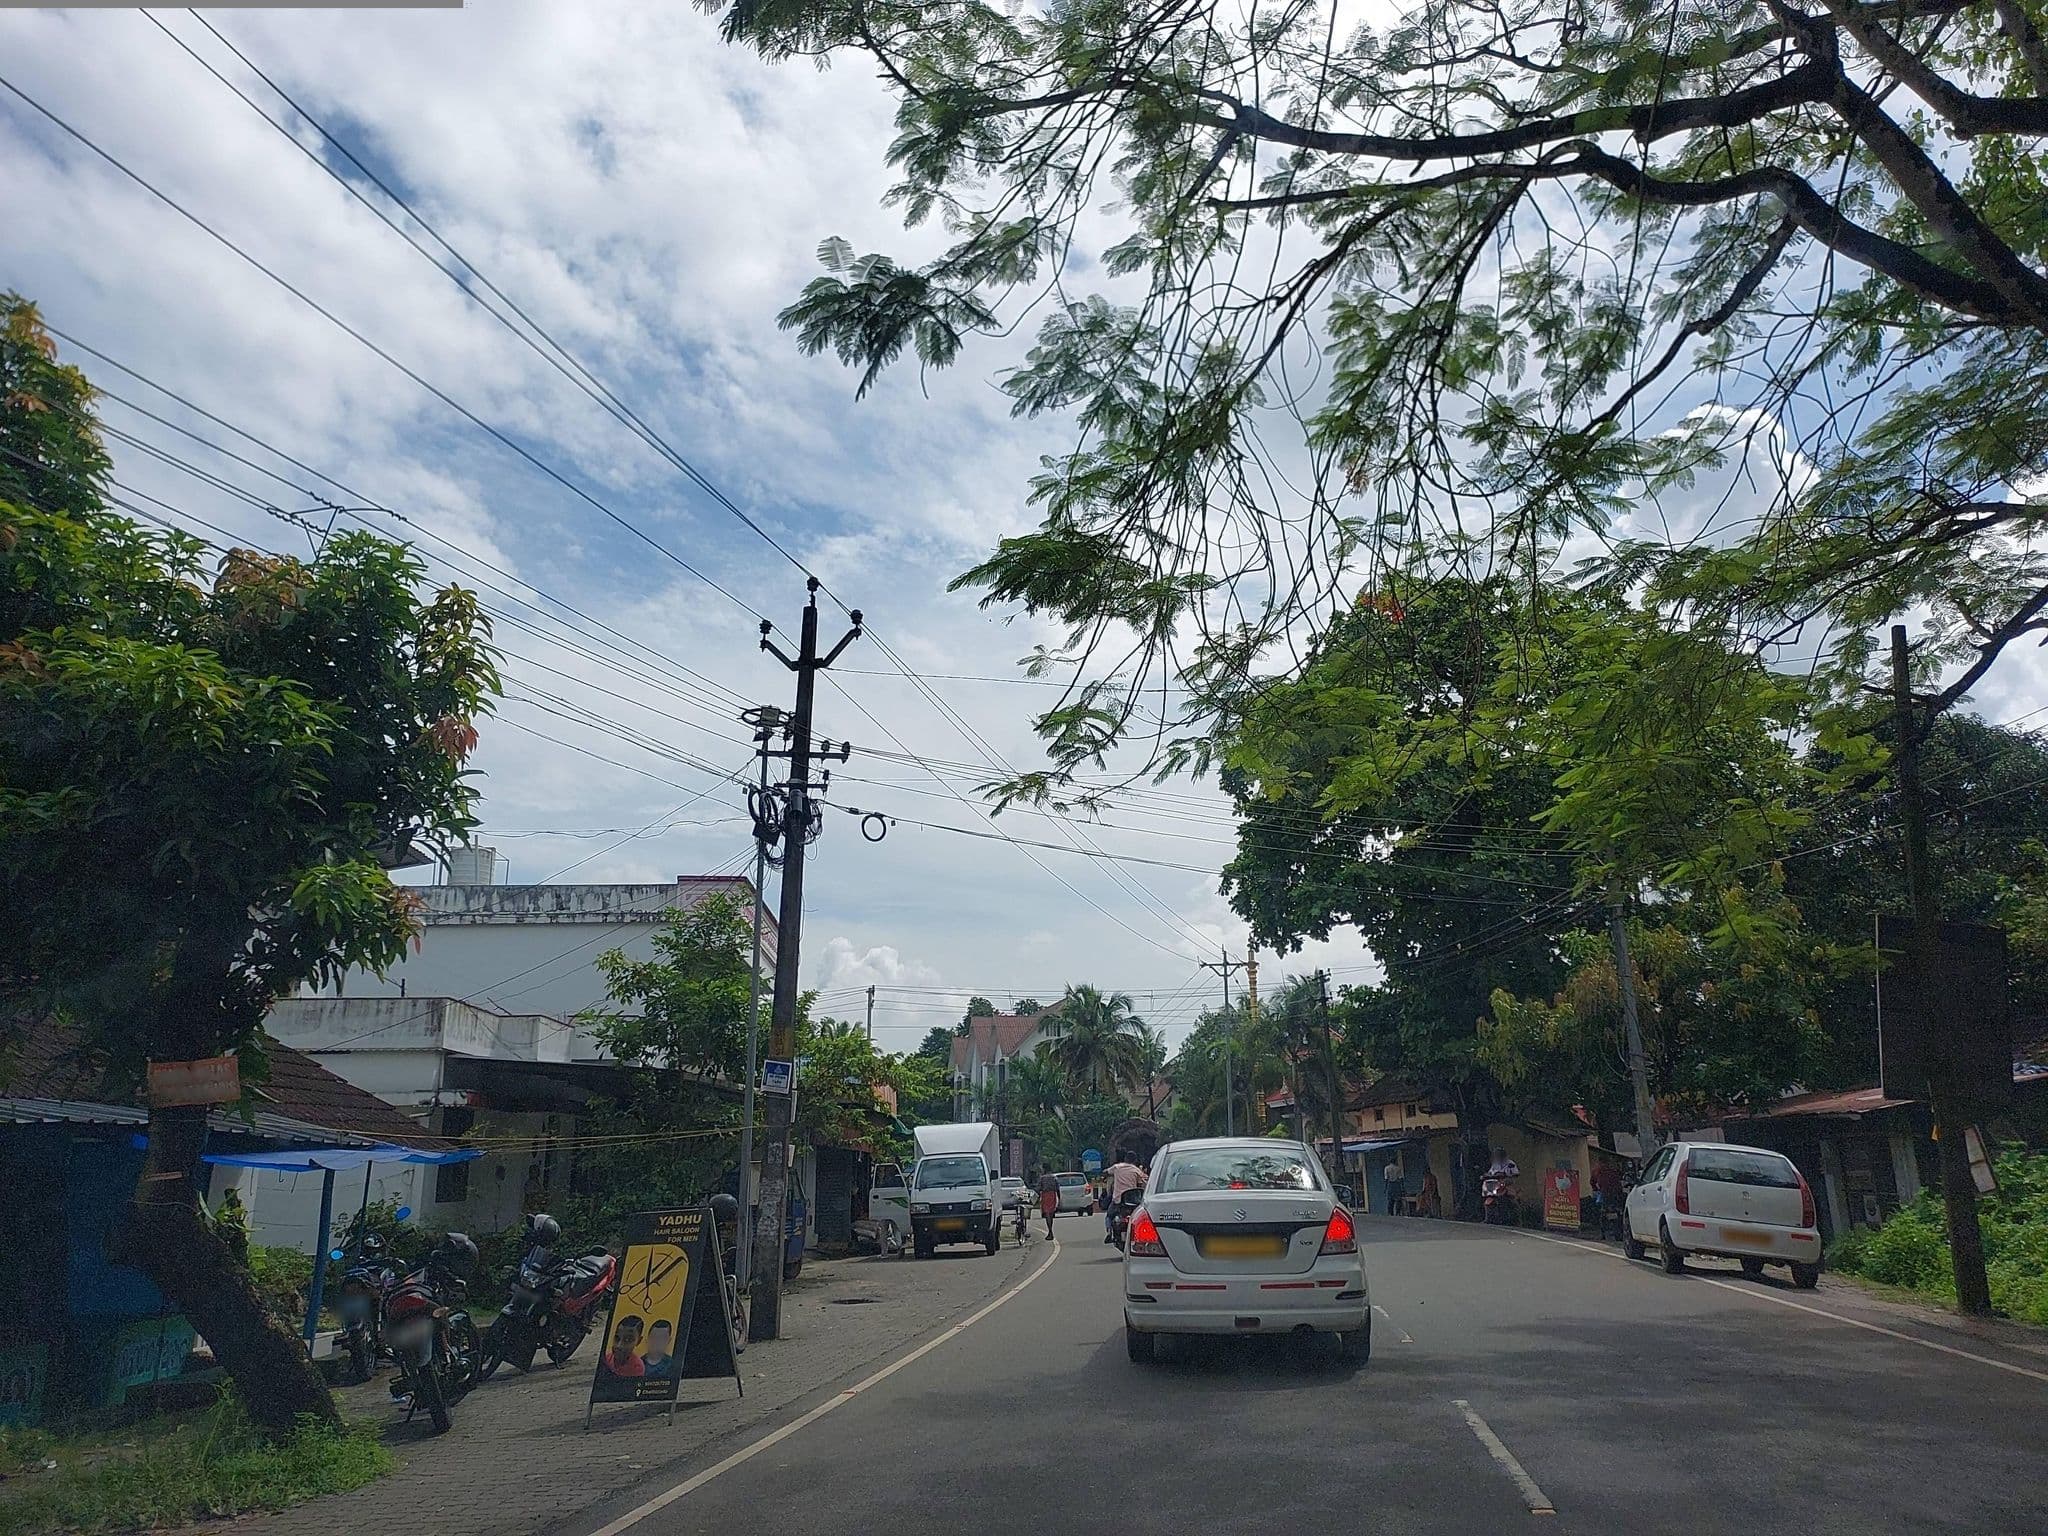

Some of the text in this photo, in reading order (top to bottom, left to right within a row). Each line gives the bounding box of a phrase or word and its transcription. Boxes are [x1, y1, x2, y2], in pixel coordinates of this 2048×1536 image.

[659, 1214, 702, 1225] YADHU
[654, 1227, 700, 1236] HAIR SALOON
